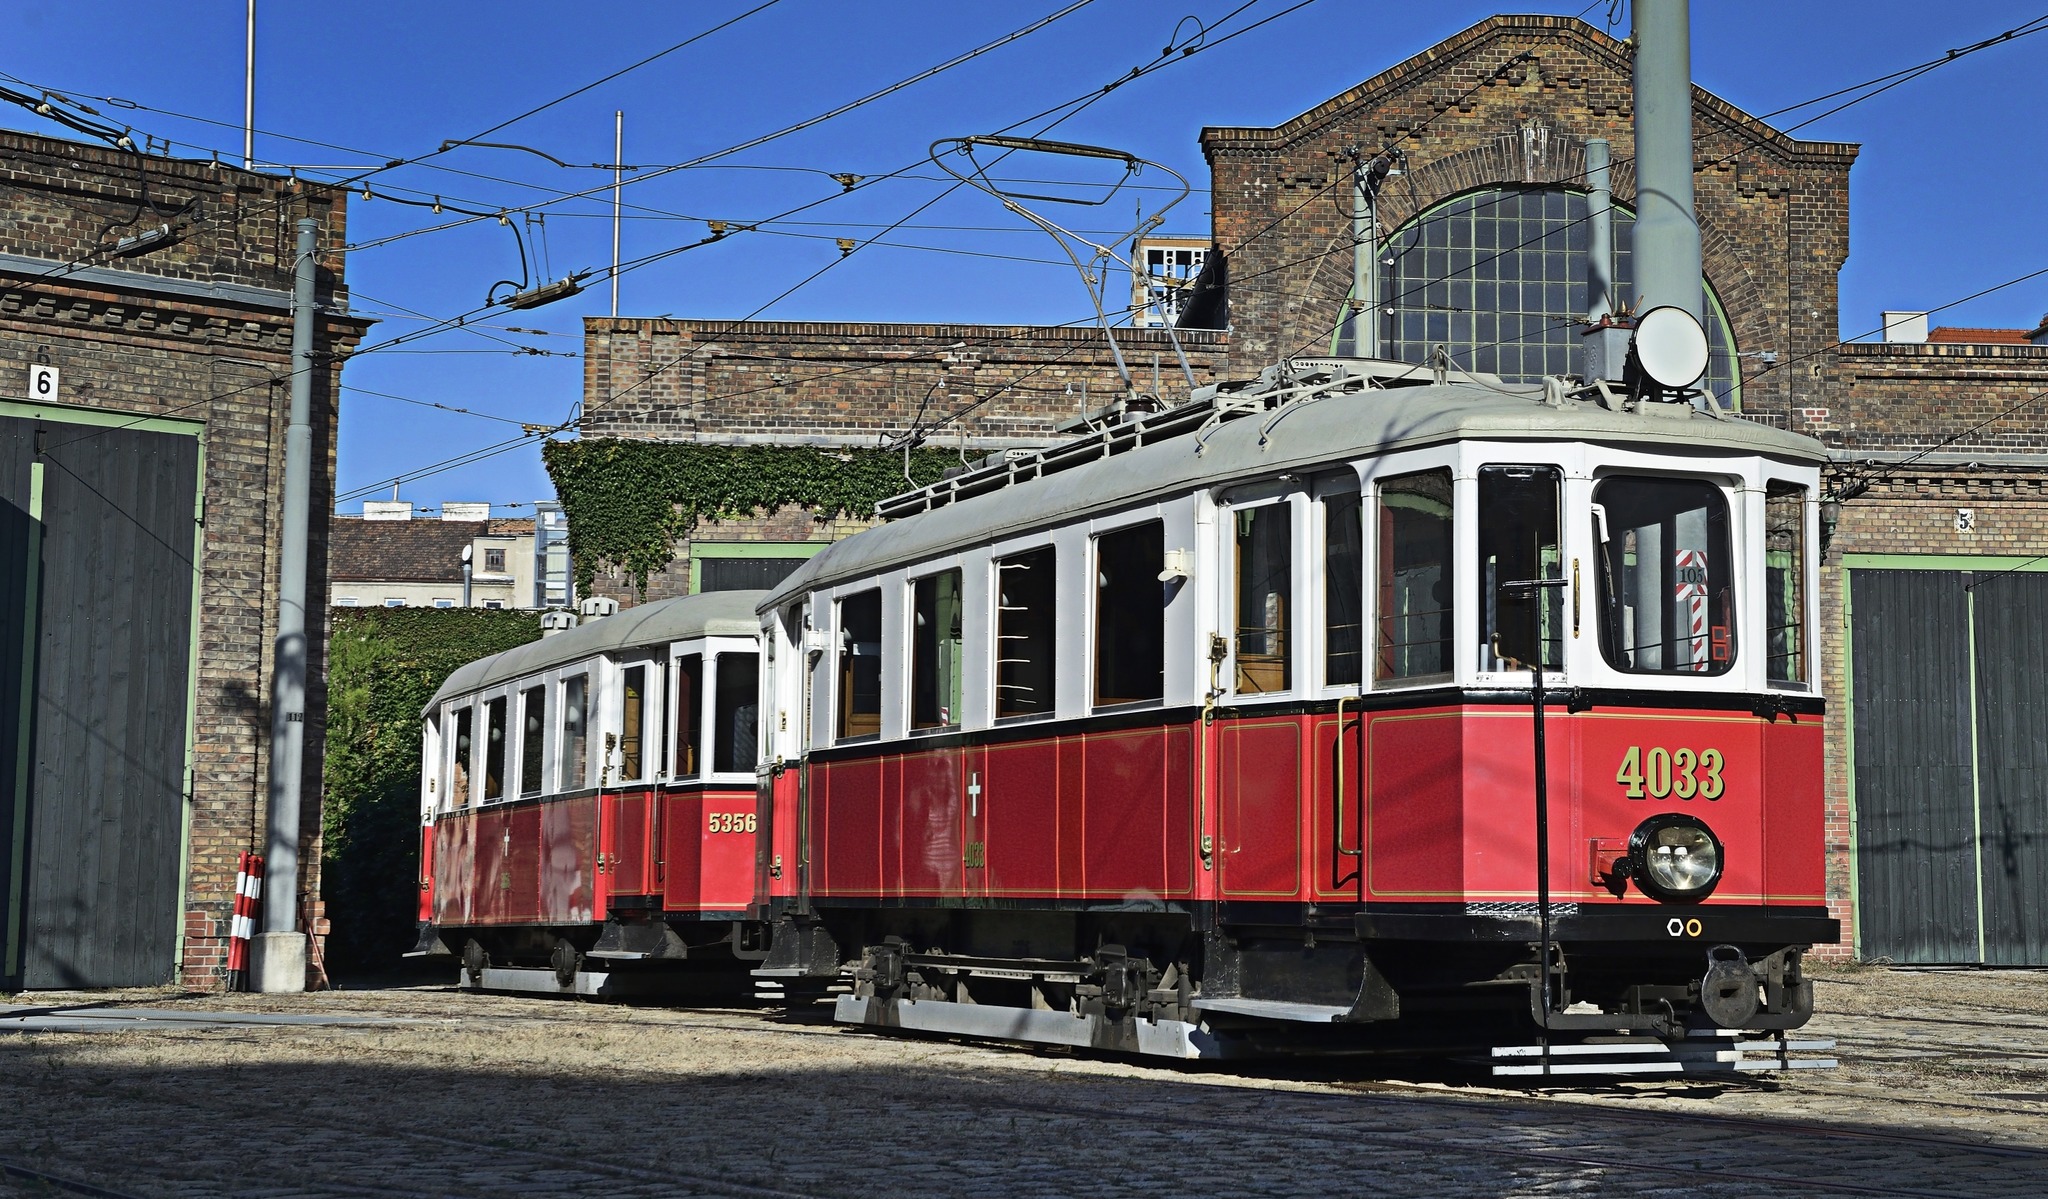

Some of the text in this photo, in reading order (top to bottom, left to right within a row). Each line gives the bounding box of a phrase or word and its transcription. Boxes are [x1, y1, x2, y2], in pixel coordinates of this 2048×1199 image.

[37, 371, 51, 394] 6
[1960, 513, 1969, 529] 5
[1680, 568, 1704, 583] 105
[1616, 746, 1725, 801] 4033
[709, 812, 757, 834] 5356
[964, 841, 984, 868] 4033
